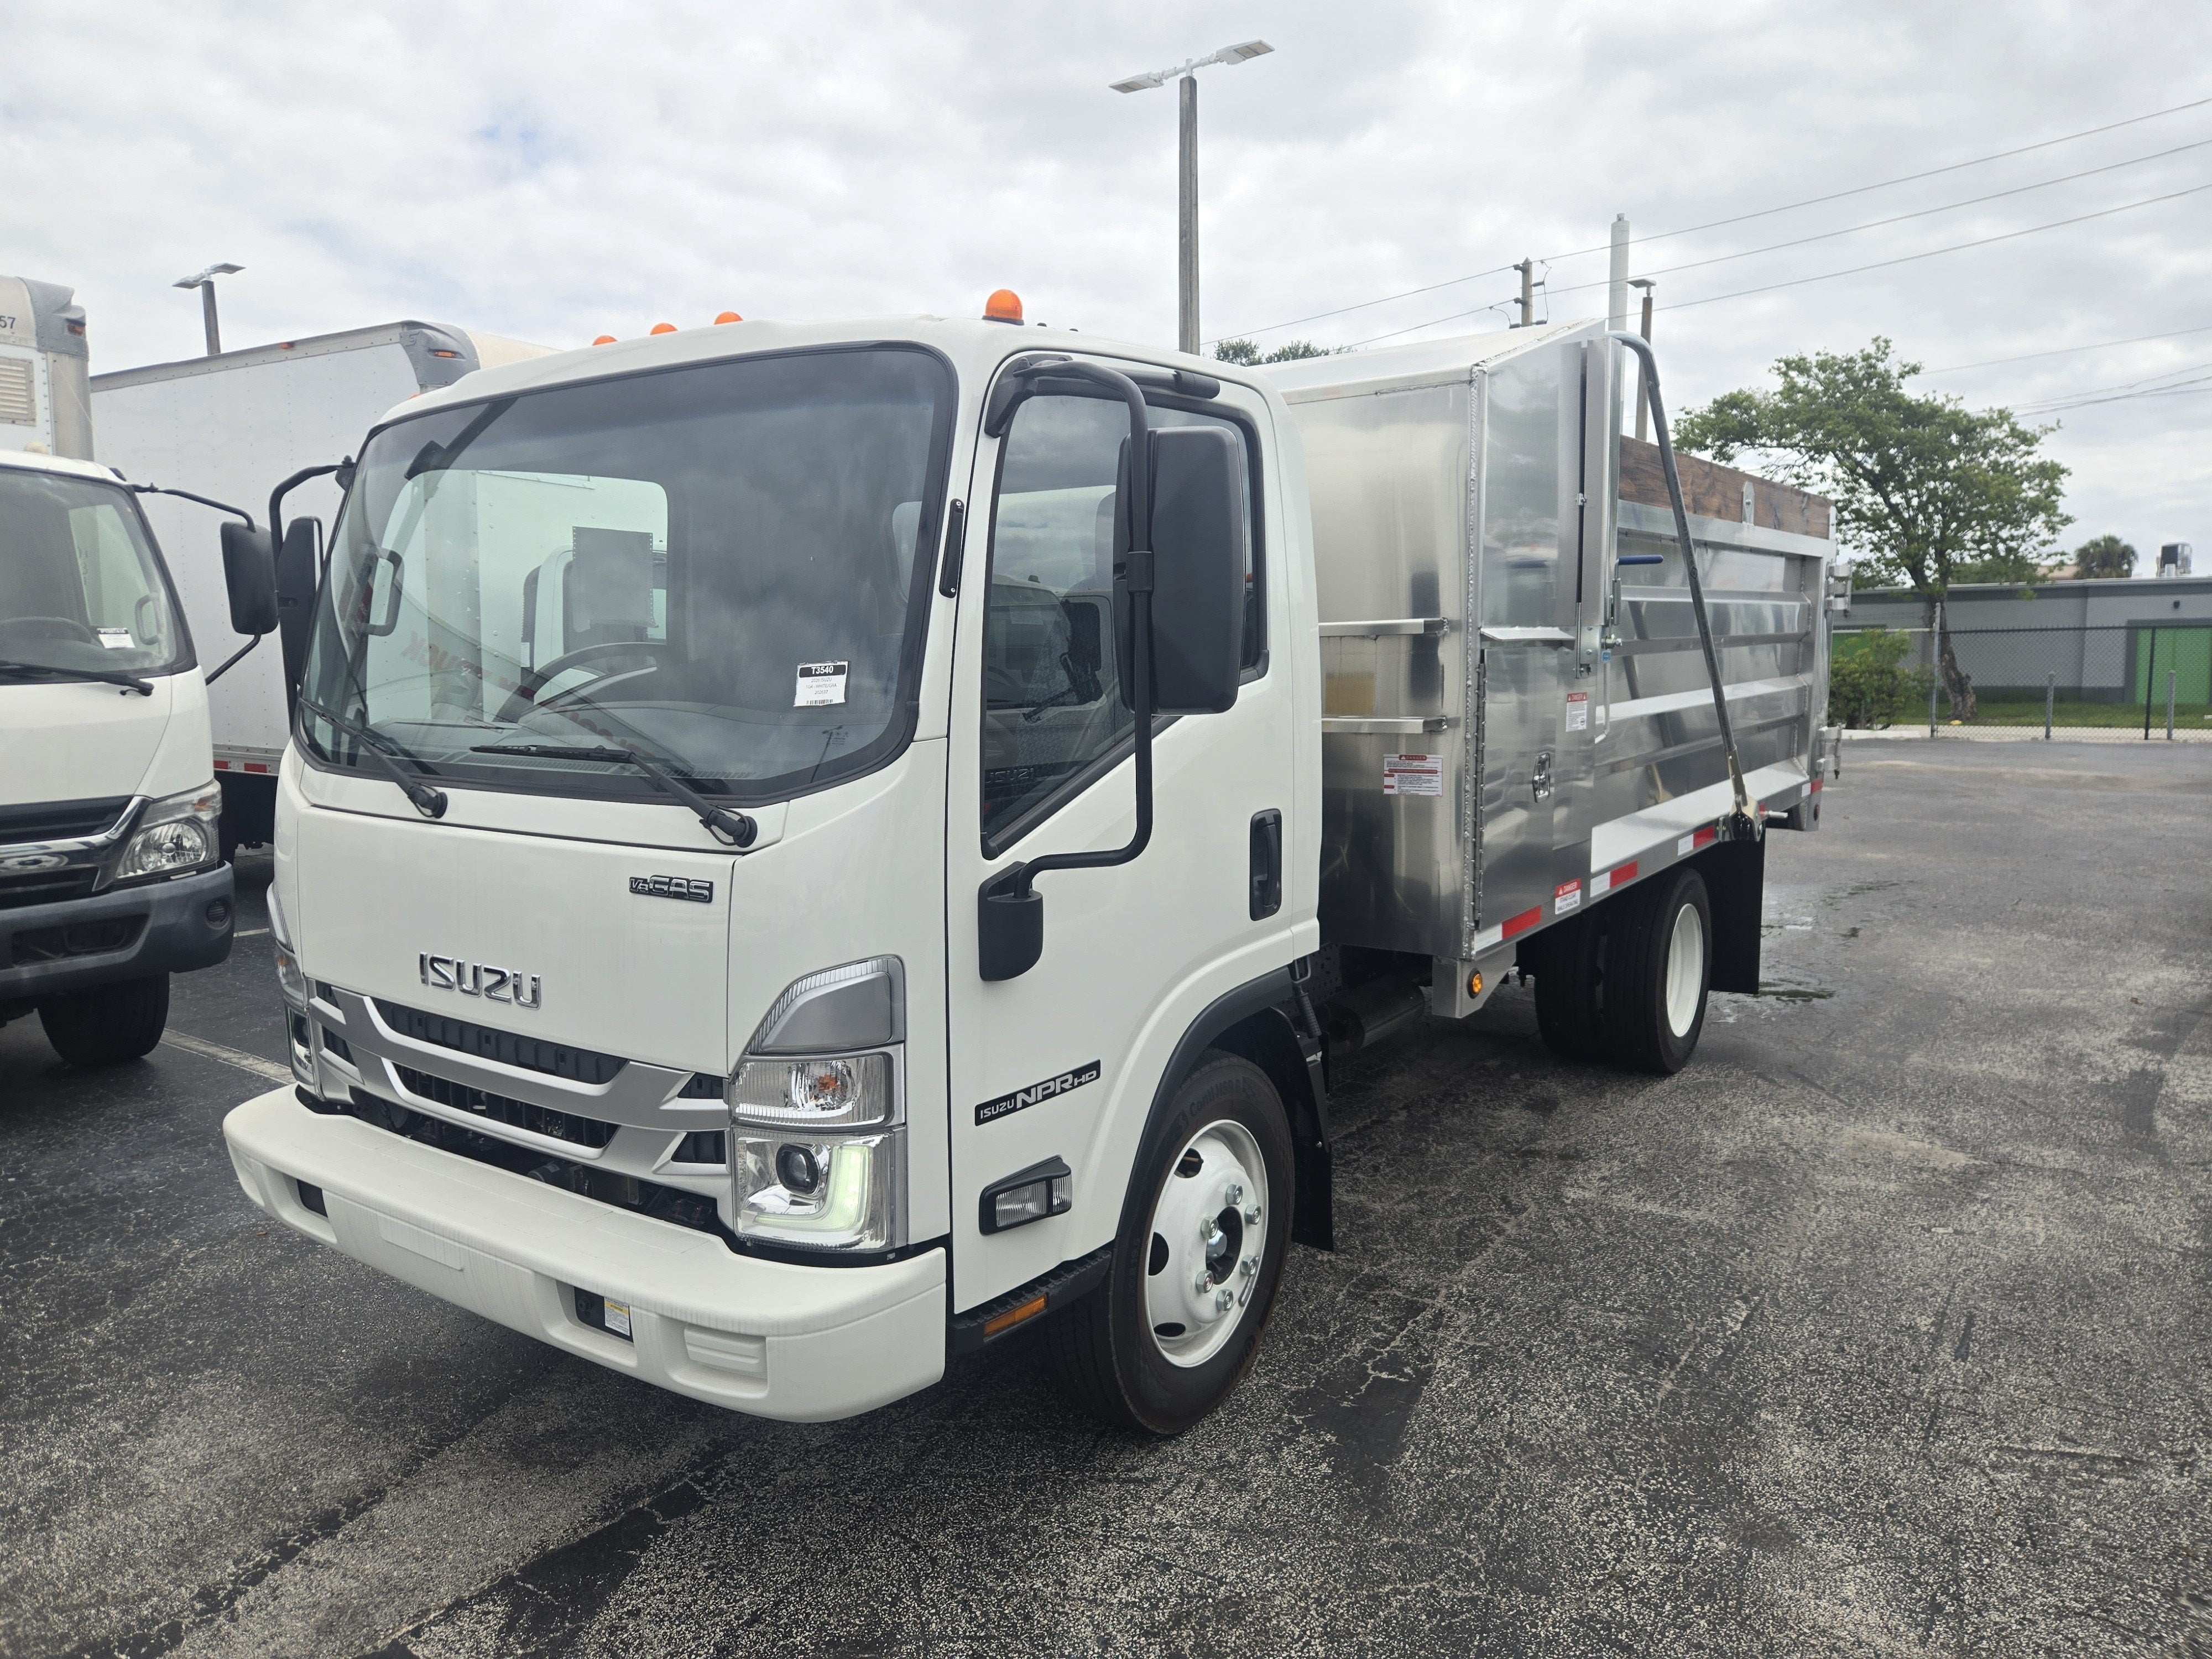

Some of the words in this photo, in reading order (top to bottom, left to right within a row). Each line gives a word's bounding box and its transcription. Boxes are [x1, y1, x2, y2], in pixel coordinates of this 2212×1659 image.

[0, 315, 17, 329] 57
[811, 665, 834, 675] T3540
[649, 875, 711, 902] GAS
[1563, 881, 1578, 893] DANGER
[419, 951, 542, 1010] ISUZU
[980, 1098, 1015, 1119] ISUZU
[1016, 1073, 1074, 1109] NPR
[1073, 1070, 1097, 1087] HD
